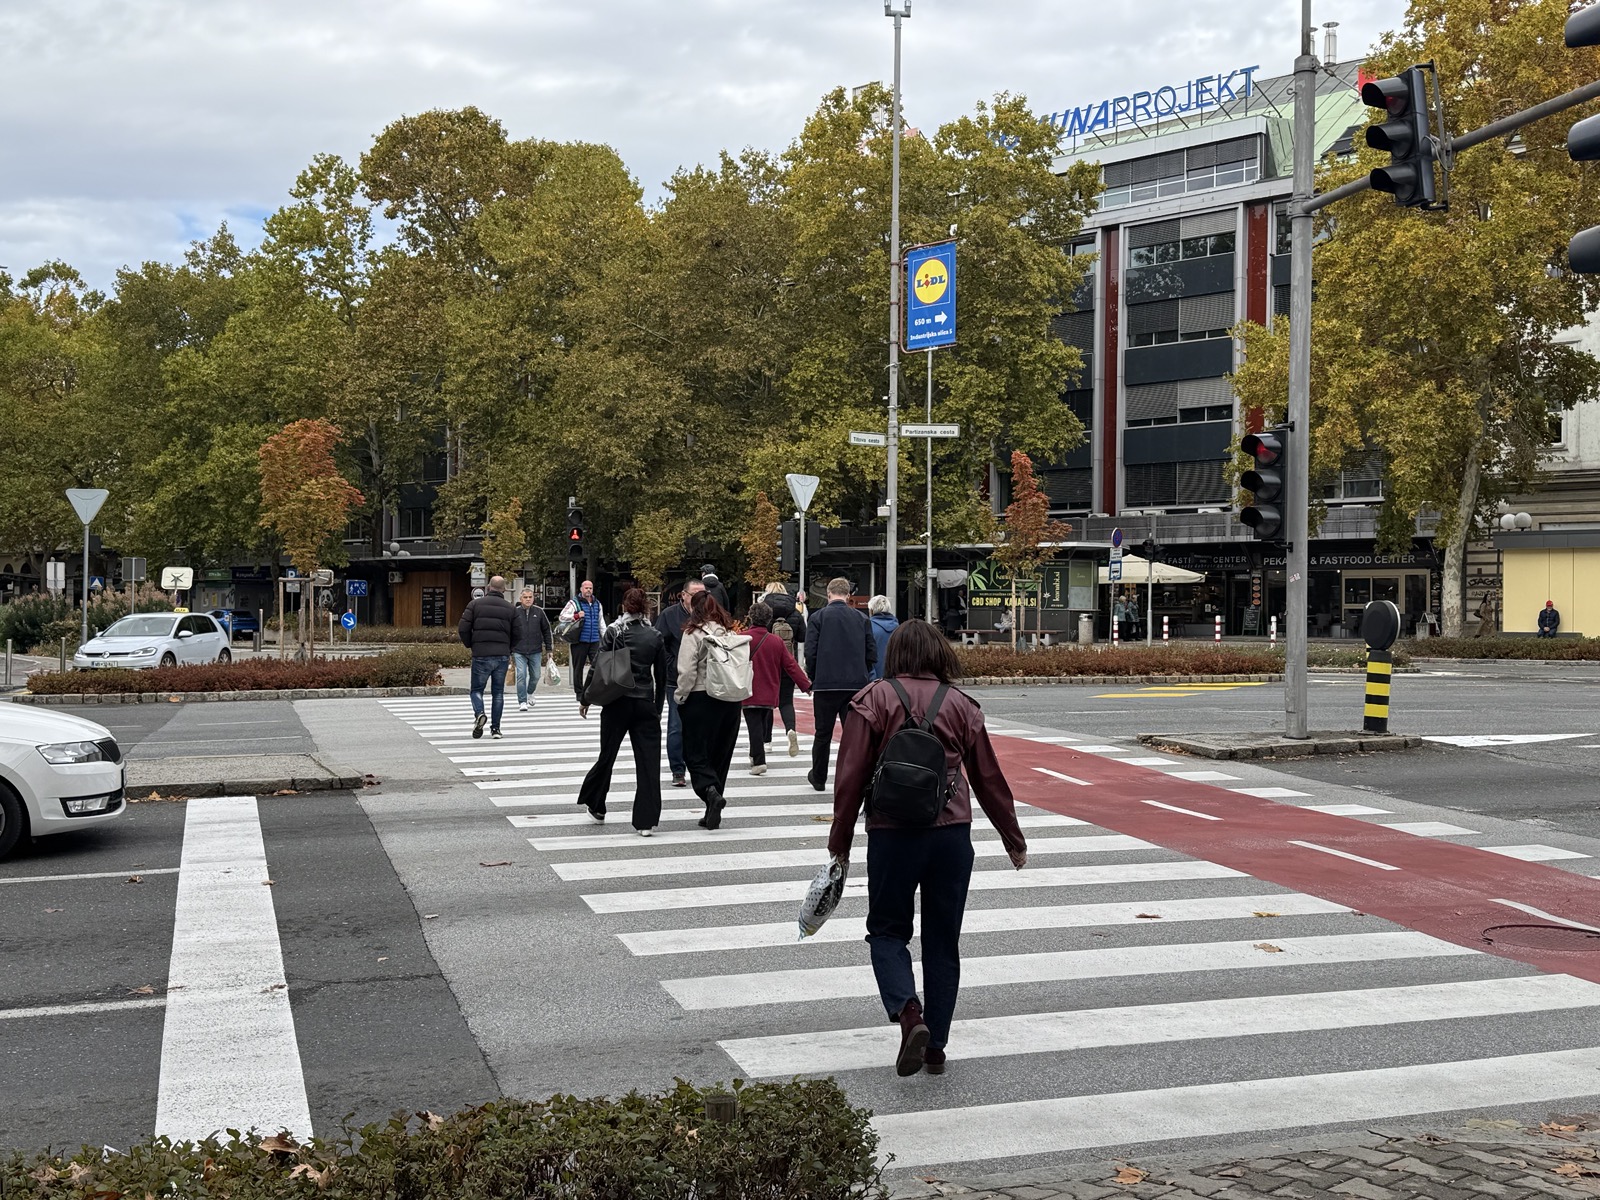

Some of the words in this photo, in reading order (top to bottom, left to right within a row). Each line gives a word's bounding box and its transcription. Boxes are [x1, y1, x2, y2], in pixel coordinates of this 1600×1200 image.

[1000, 65, 1260, 149] UNAPROJEKT
[914, 318, 925, 327] 650
[1213, 555, 1247, 564] CENTER
[1310, 556, 1318, 565] &
[1319, 556, 1372, 565] FASTFOOD
[971, 597, 984, 606] CBD
[985, 597, 1002, 607] SHOP
